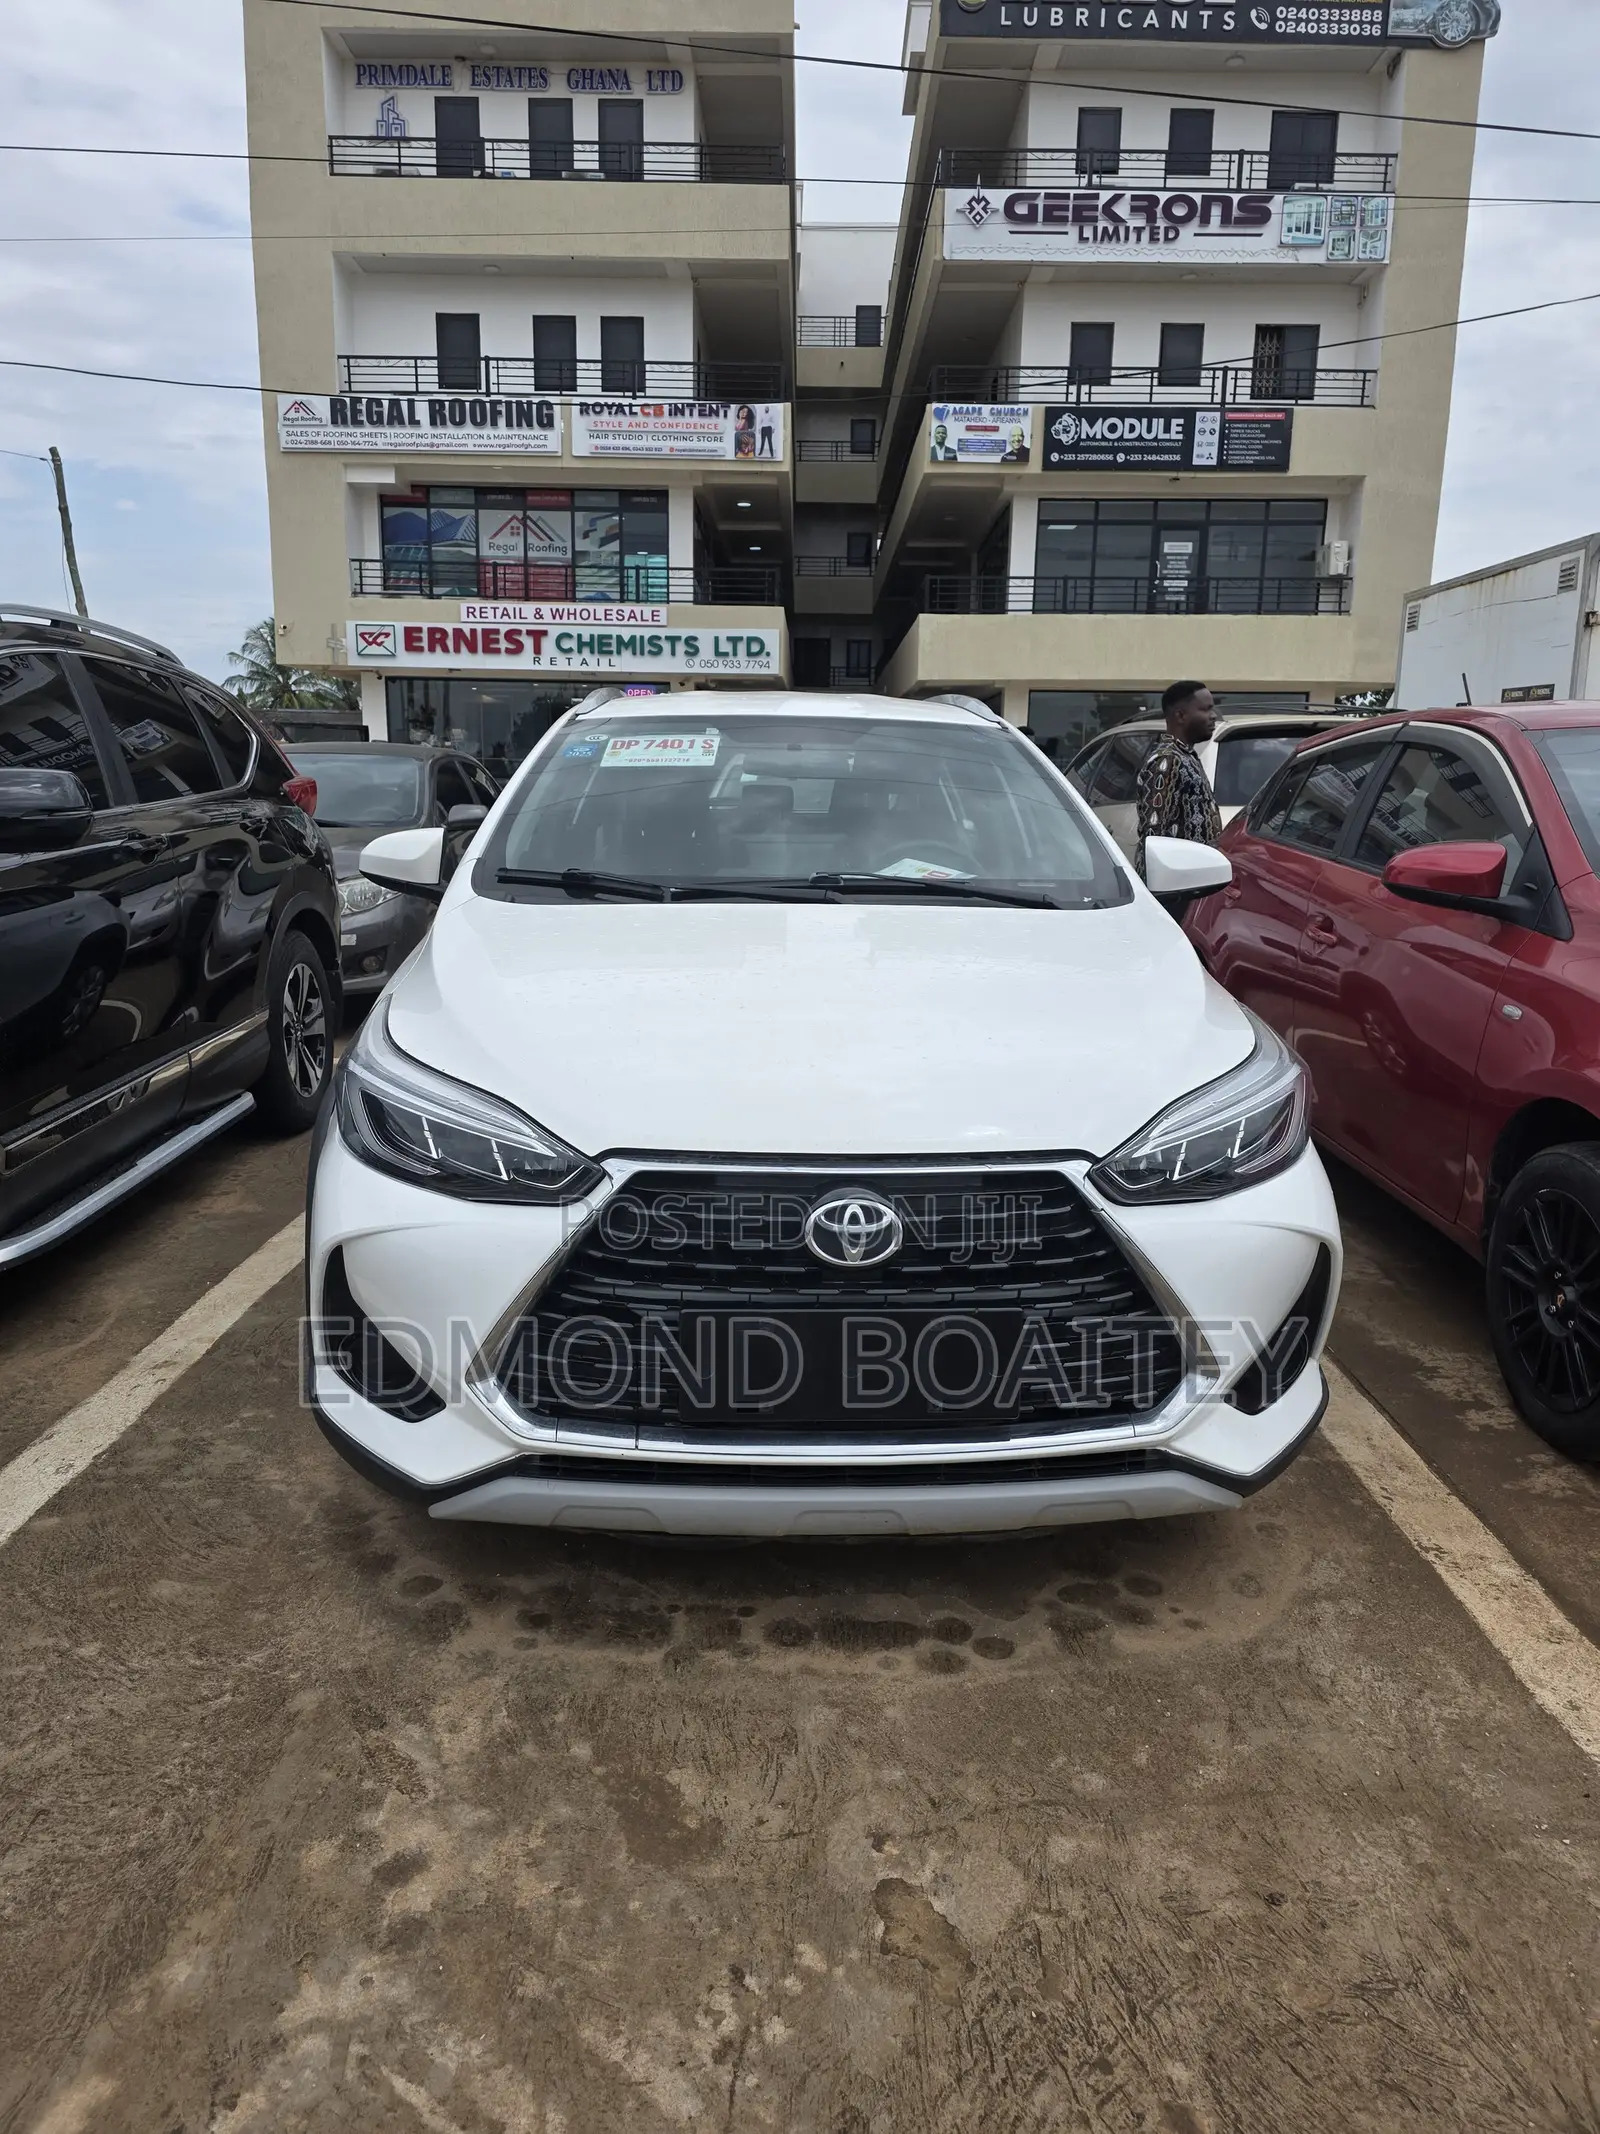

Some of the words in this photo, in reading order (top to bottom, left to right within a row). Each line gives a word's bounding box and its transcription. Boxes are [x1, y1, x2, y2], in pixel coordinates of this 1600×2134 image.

[1001, 6, 1236, 30] LUBRICANTS
[1276, 6, 1383, 22] 0240333888
[1275, 21, 1382, 36] 0240333036
[355, 64, 452, 87] PRIMDALE
[470, 65, 548, 89] ESTATES
[566, 68, 632, 92] GHANA
[646, 69, 684, 92] LTD
[1003, 192, 1274, 227] GEEKRONS
[1078, 225, 1180, 244] LIMITED
[329, 398, 421, 426] REGAL
[428, 398, 554, 428] ROOFING
[579, 402, 638, 417] ROYAL
[952, 407, 983, 415] AGAPE
[989, 407, 1029, 416] CHURCH
[592, 421, 623, 429] STYLE
[653, 422, 719, 430] CONFIDENCE
[1081, 417, 1184, 440] MODULE
[651, 435, 694, 443] CLOTHING
[488, 541, 518, 554] Regal
[528, 543, 568, 556] Roofing
[466, 605, 527, 620] RETAIL
[533, 607, 545, 621] &
[550, 607, 661, 622] WHOLESALE
[403, 626, 548, 655] ERNEST
[555, 632, 700, 657] CHEMISTS
[713, 635, 771, 658] LTD.
[533, 656, 616, 668] RETAIL
[699, 658, 721, 669] 050
[722, 659, 743, 670] 933
[744, 659, 771, 670] 7794
[627, 688, 654, 696] OPEN
[611, 739, 640, 750] DP
[643, 738, 696, 750] 7401
[701, 738, 715, 749] S
